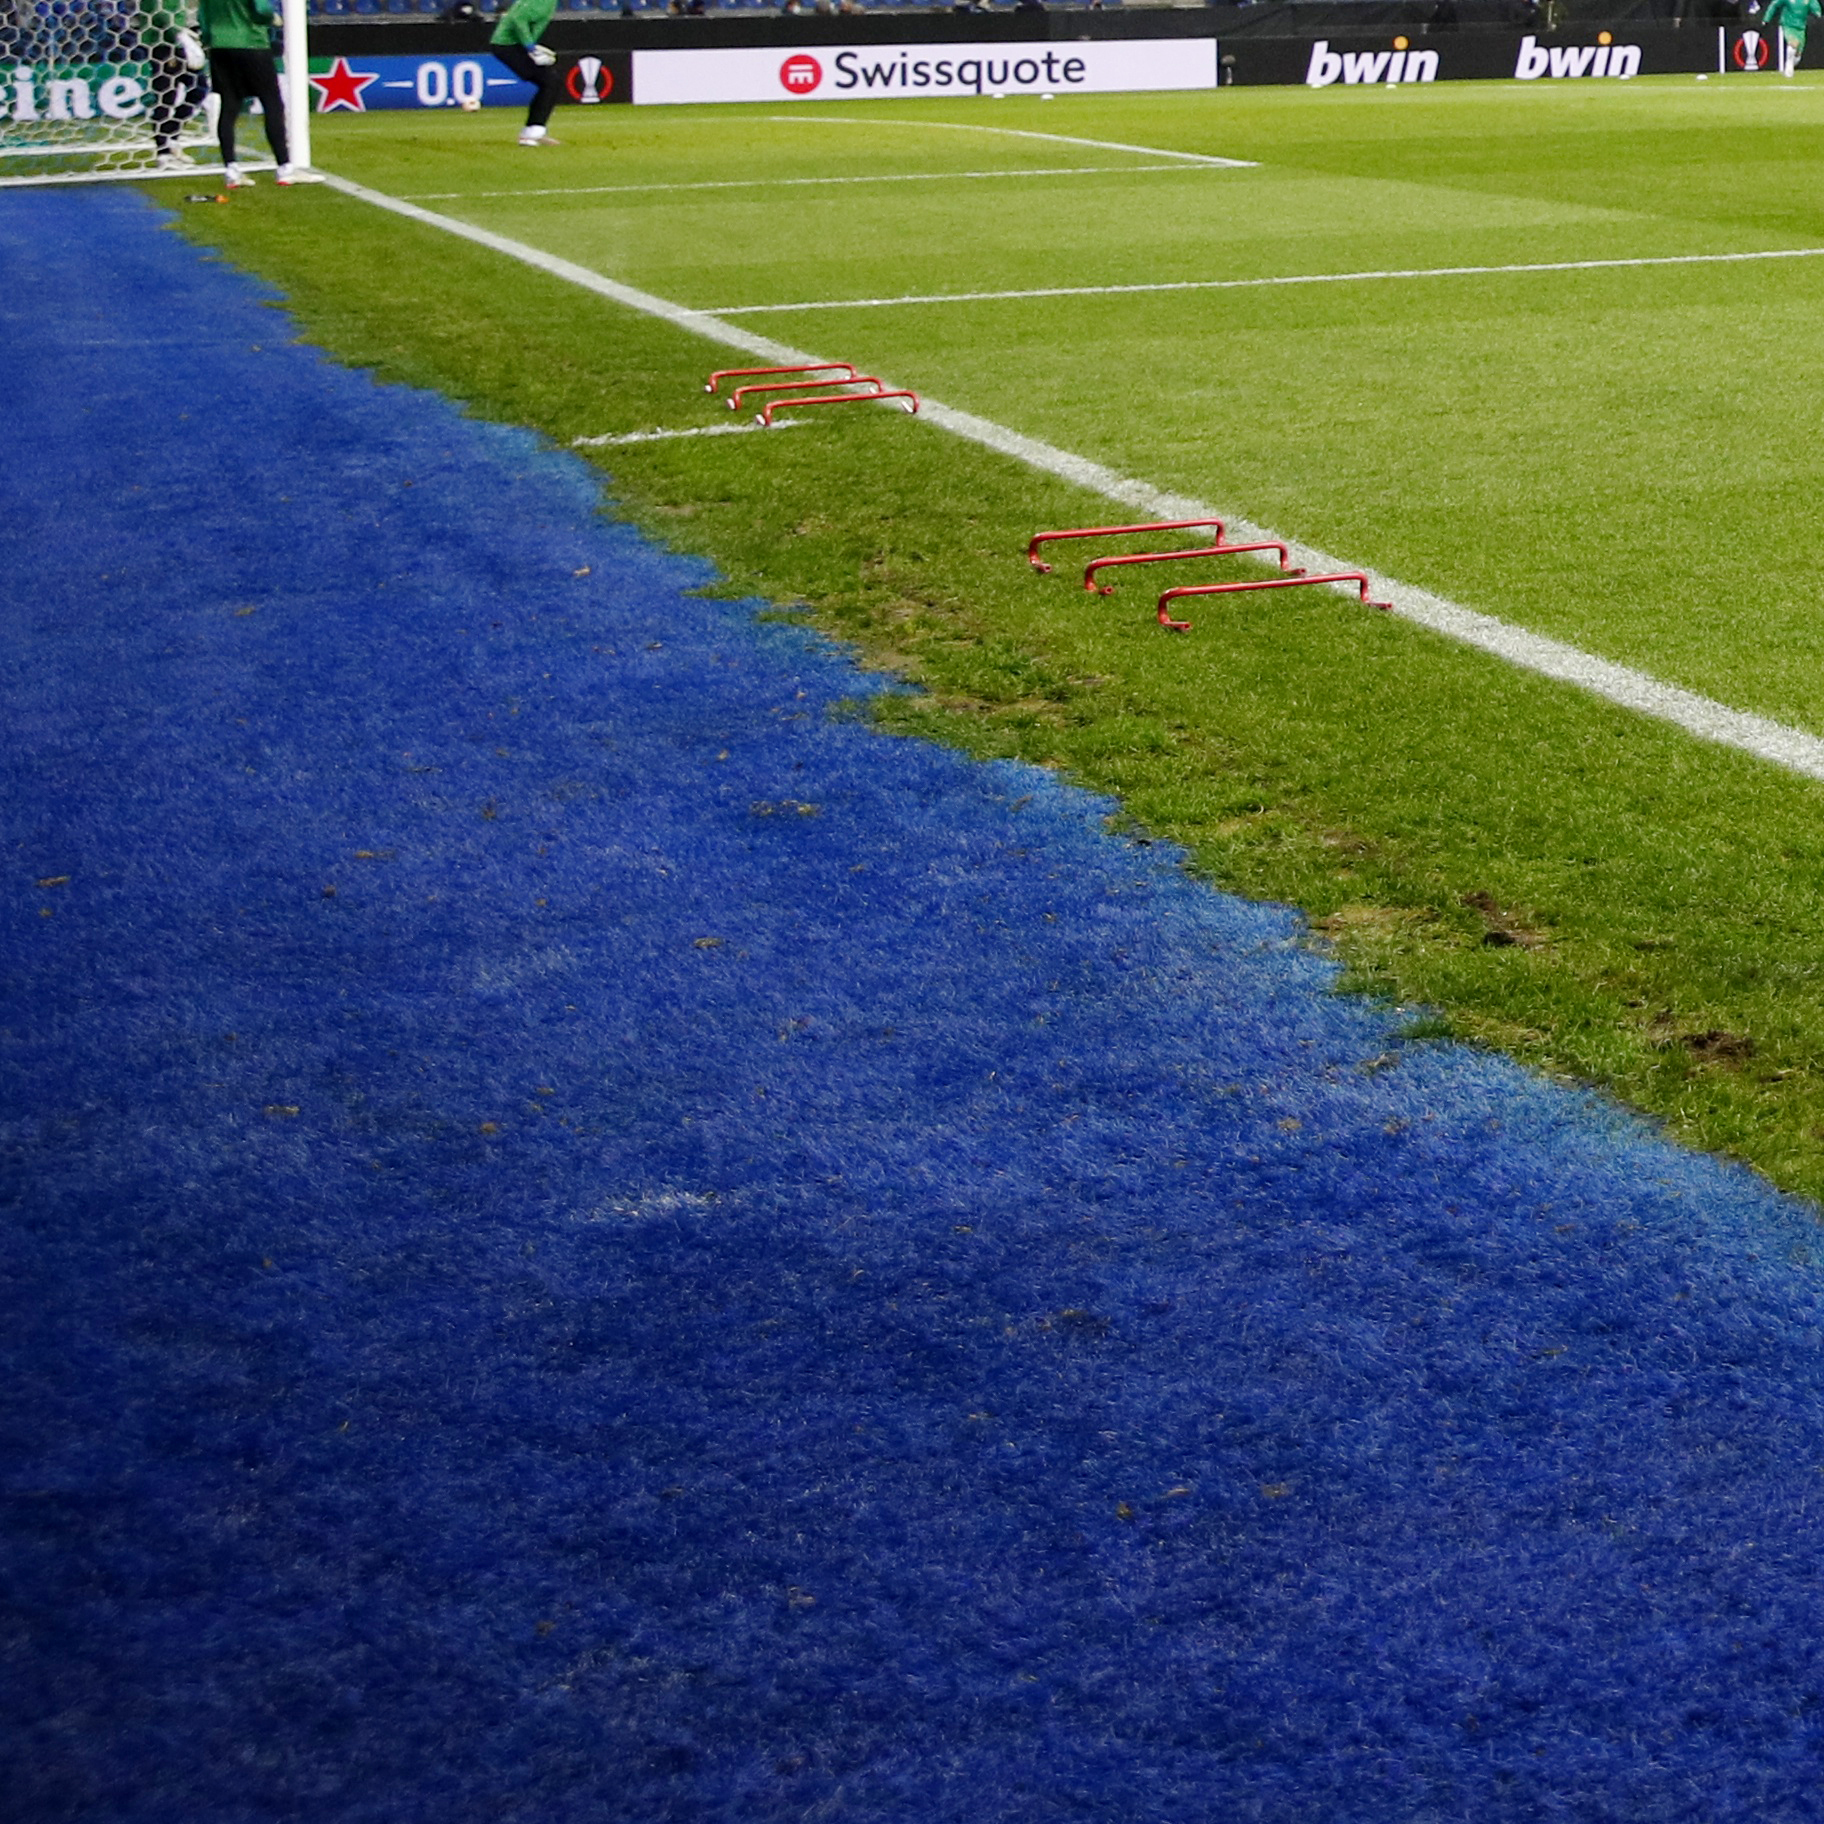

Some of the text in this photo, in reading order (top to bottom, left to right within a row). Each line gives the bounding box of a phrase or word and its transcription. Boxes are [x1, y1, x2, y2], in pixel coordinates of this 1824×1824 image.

[835, 50, 1087, 94] Swissquote
[1306, 35, 1440, 86] bwin
[1514, 31, 1642, 80] bwin
